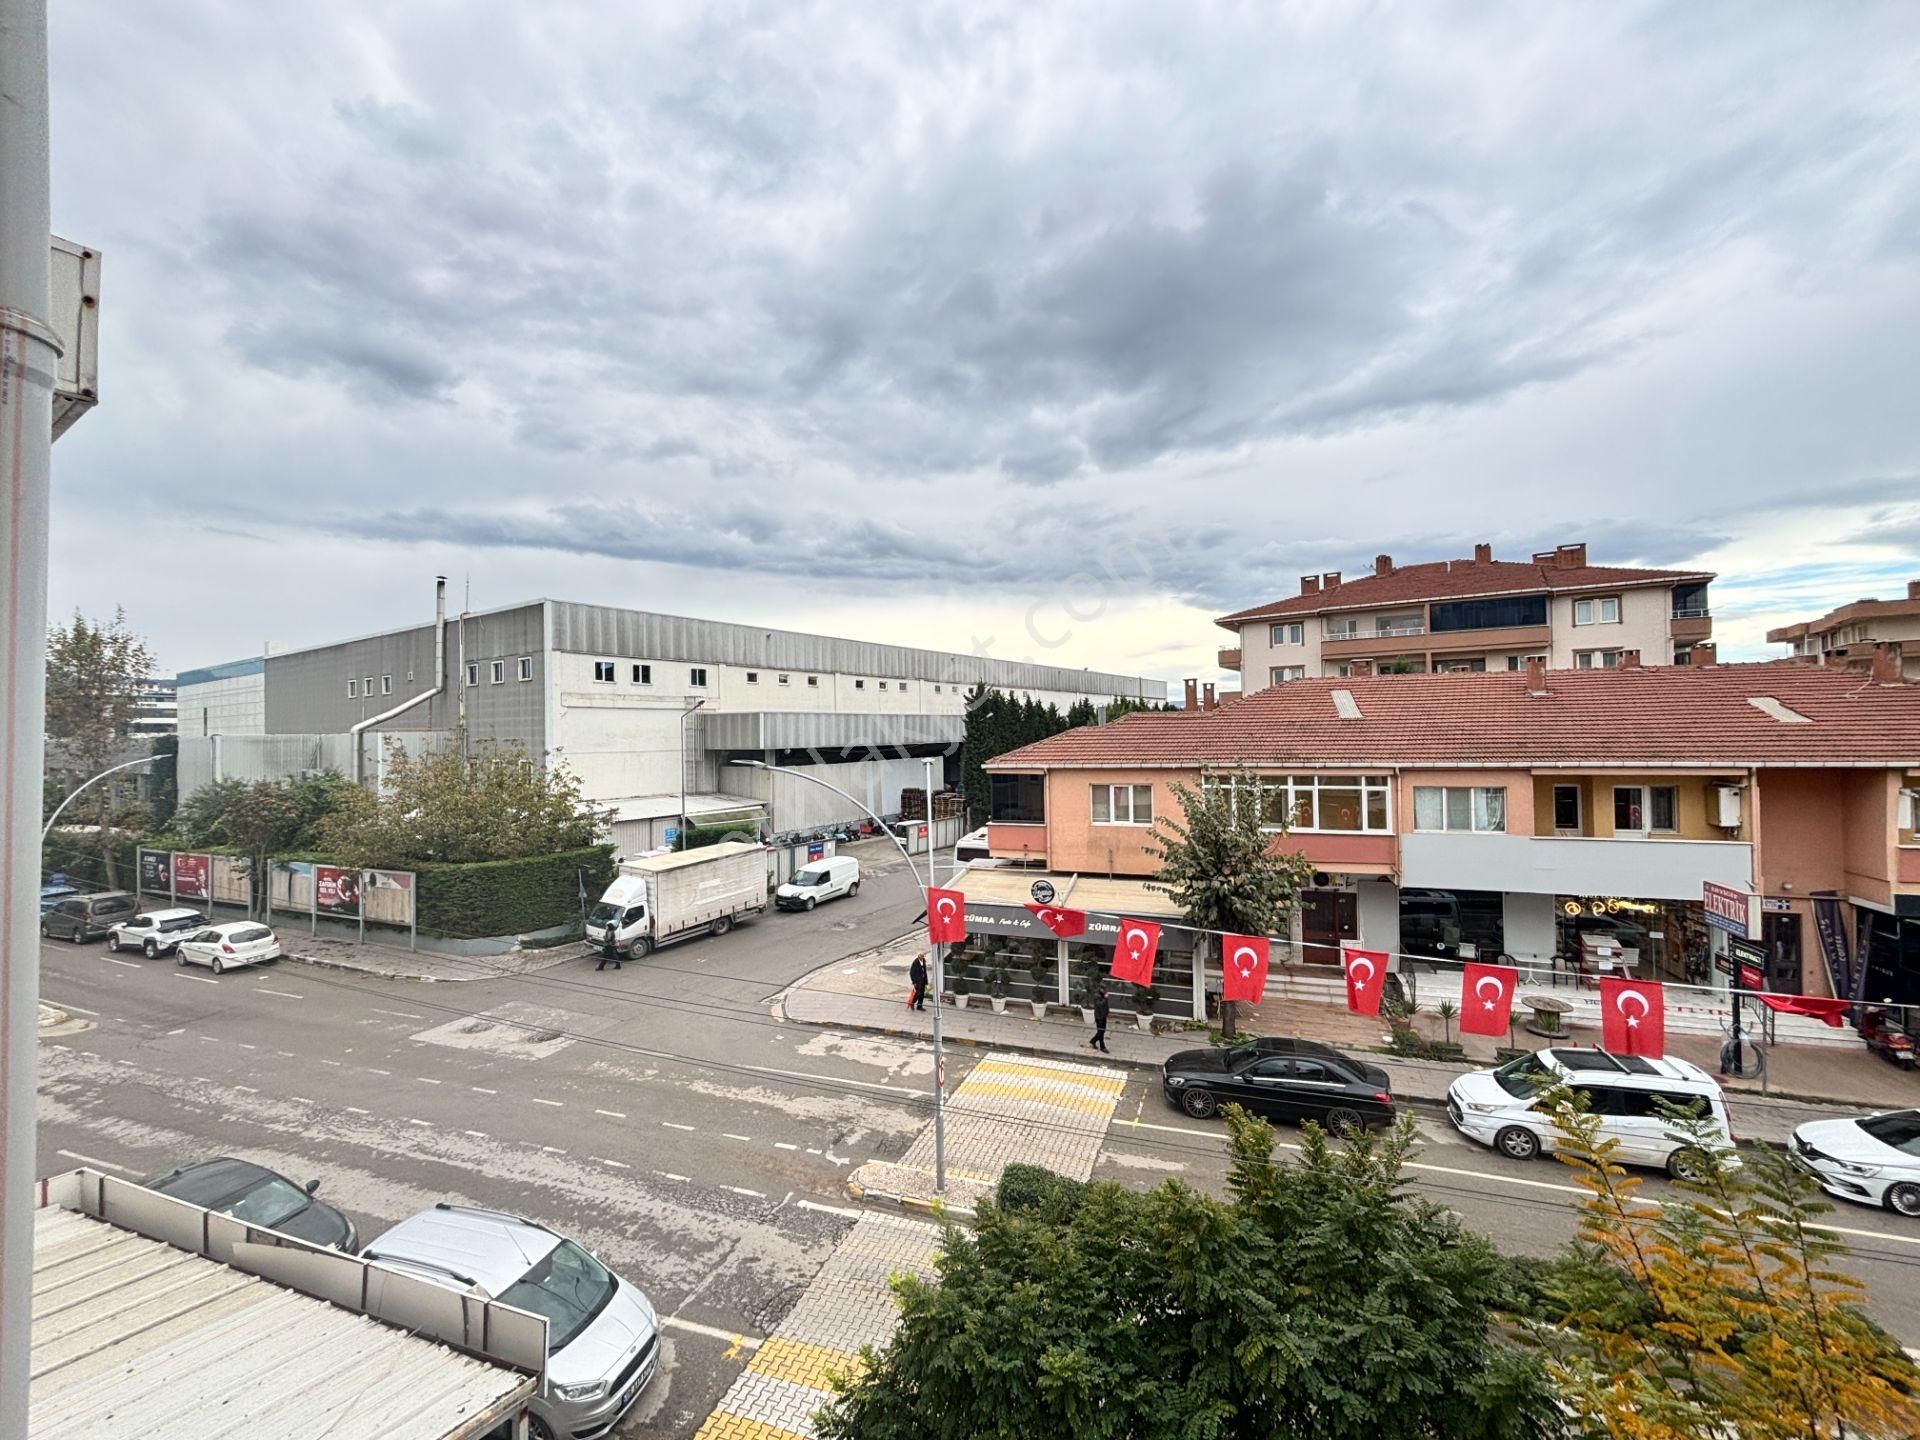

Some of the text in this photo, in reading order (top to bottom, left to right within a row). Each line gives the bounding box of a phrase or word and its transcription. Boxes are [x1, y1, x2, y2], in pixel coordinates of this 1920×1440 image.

[964, 913, 995, 924] ZÜMRA
[1704, 891, 1746, 925] ELEKTRİK
[1835, 935, 1847, 962] COFFEE
